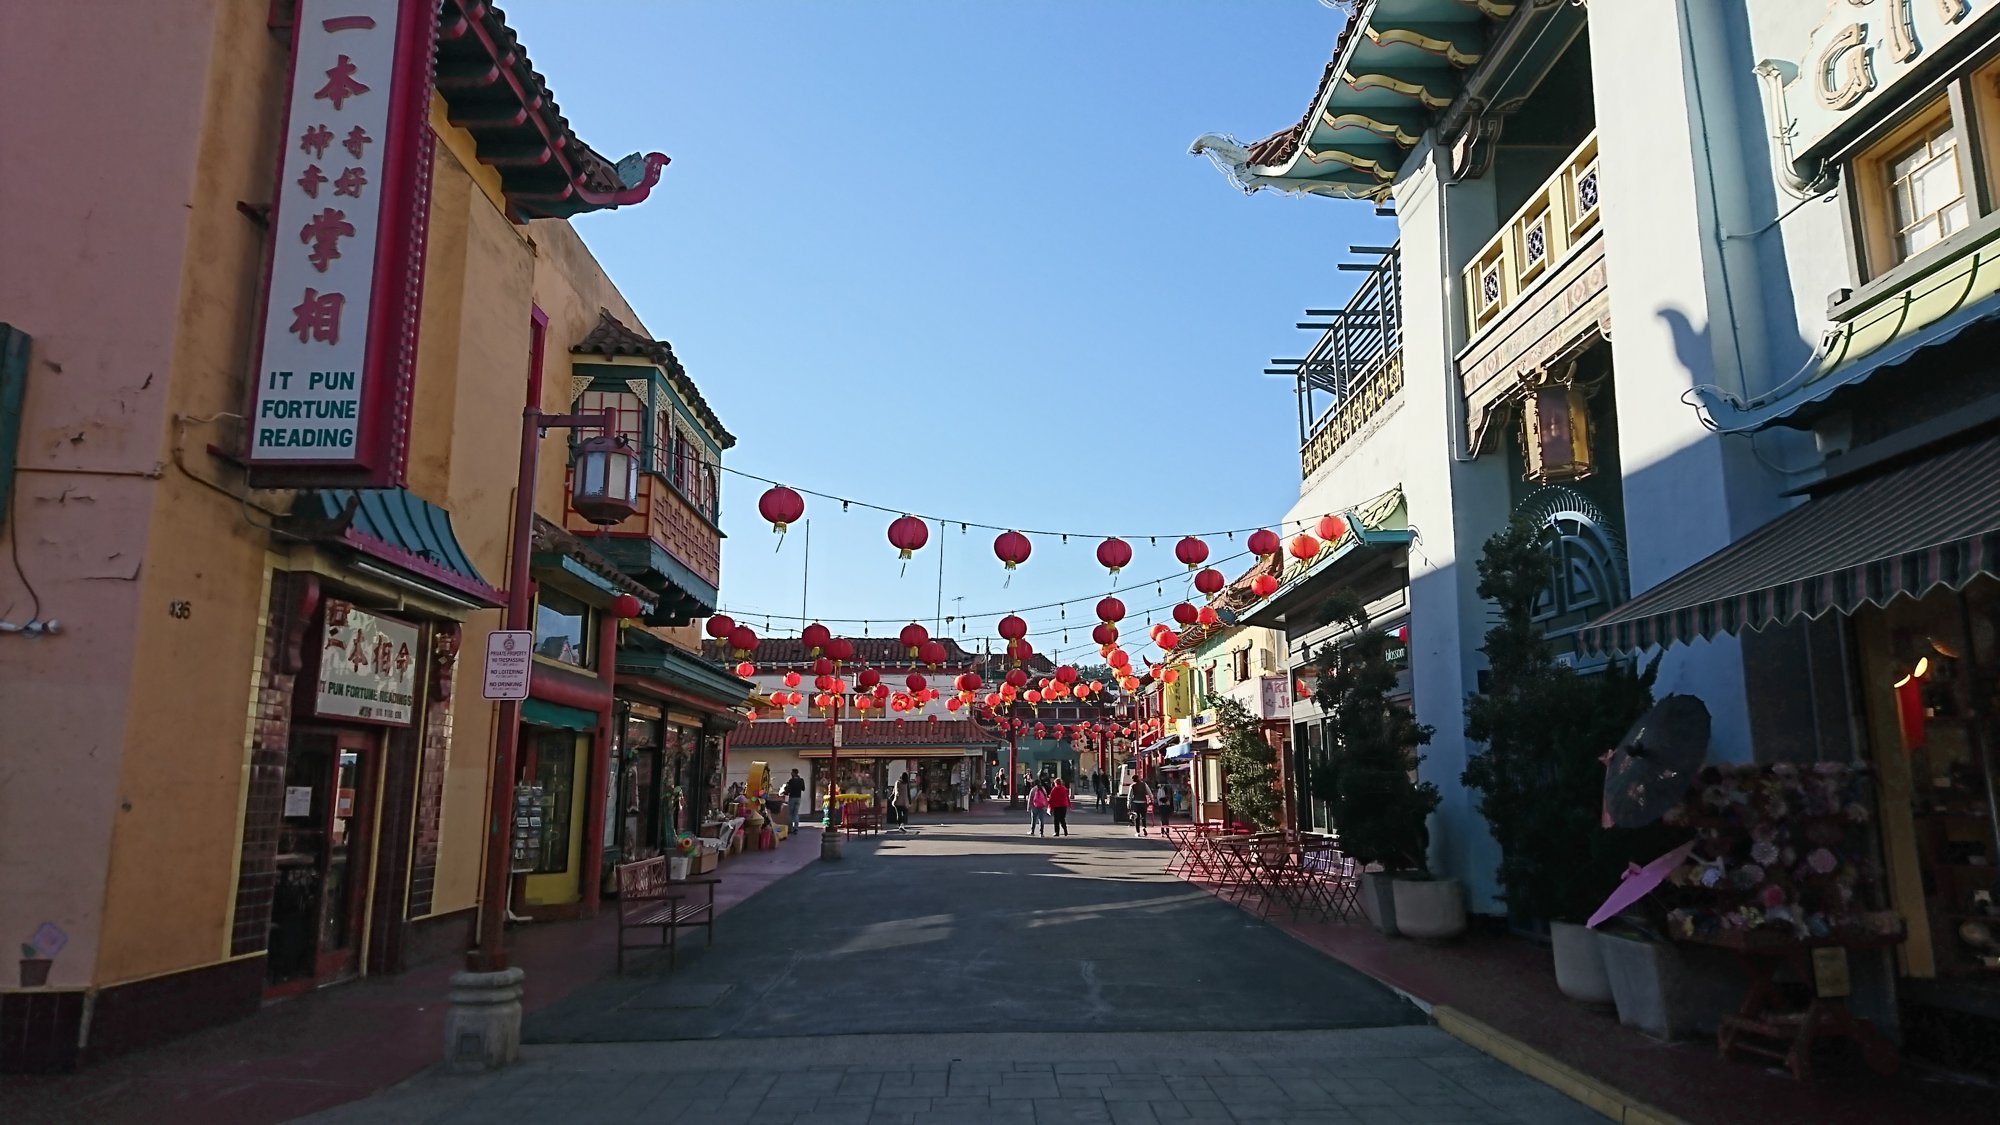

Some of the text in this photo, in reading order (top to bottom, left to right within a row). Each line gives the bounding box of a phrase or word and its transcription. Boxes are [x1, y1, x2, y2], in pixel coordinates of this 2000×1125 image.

[314, 15, 377, 111] 一本
[289, 207, 356, 346] 掌相
[269, 372, 355, 390] IT PUN
[261, 400, 357, 419] FORTUNE
[259, 429, 353, 447] READING
[328, 682, 344, 696] PUN
[345, 685, 378, 701] FORTUNE
[379, 691, 412, 706] READINGS
